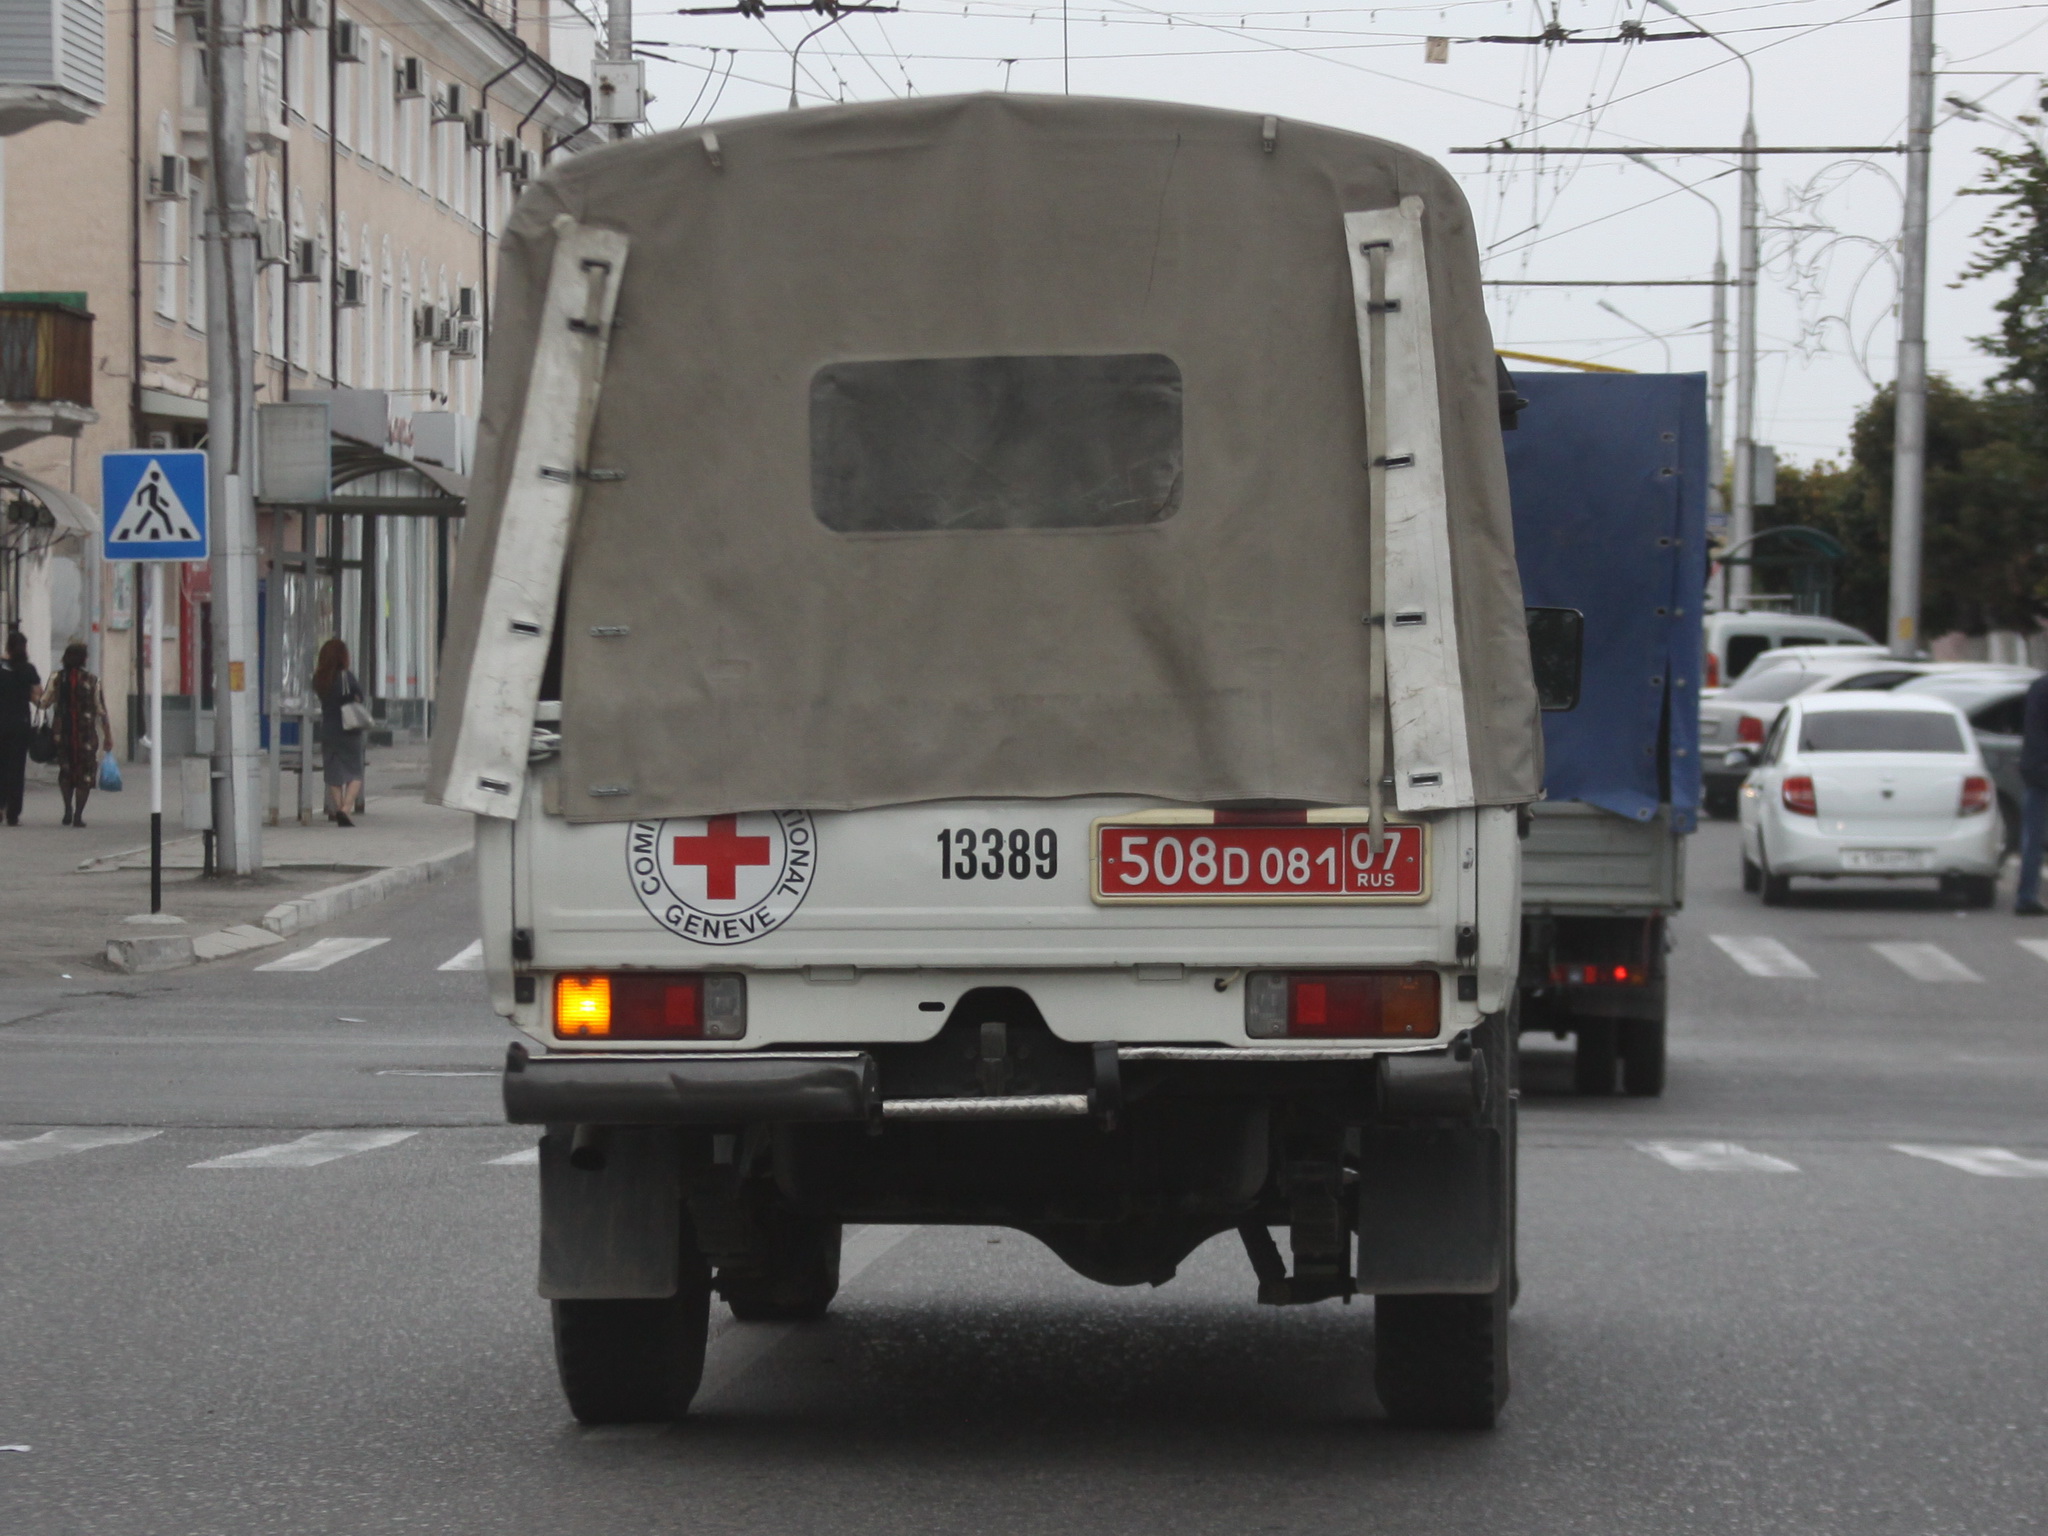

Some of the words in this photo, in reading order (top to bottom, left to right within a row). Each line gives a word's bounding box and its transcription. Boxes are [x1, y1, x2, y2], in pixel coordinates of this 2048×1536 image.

[633, 818, 660, 896] COMI
[778, 809, 811, 896] TIONAL
[937, 827, 1058, 880] 13389
[1350, 831, 1402, 871] 07
[1357, 873, 1395, 887] RUS
[665, 904, 776, 939] GENEVE
